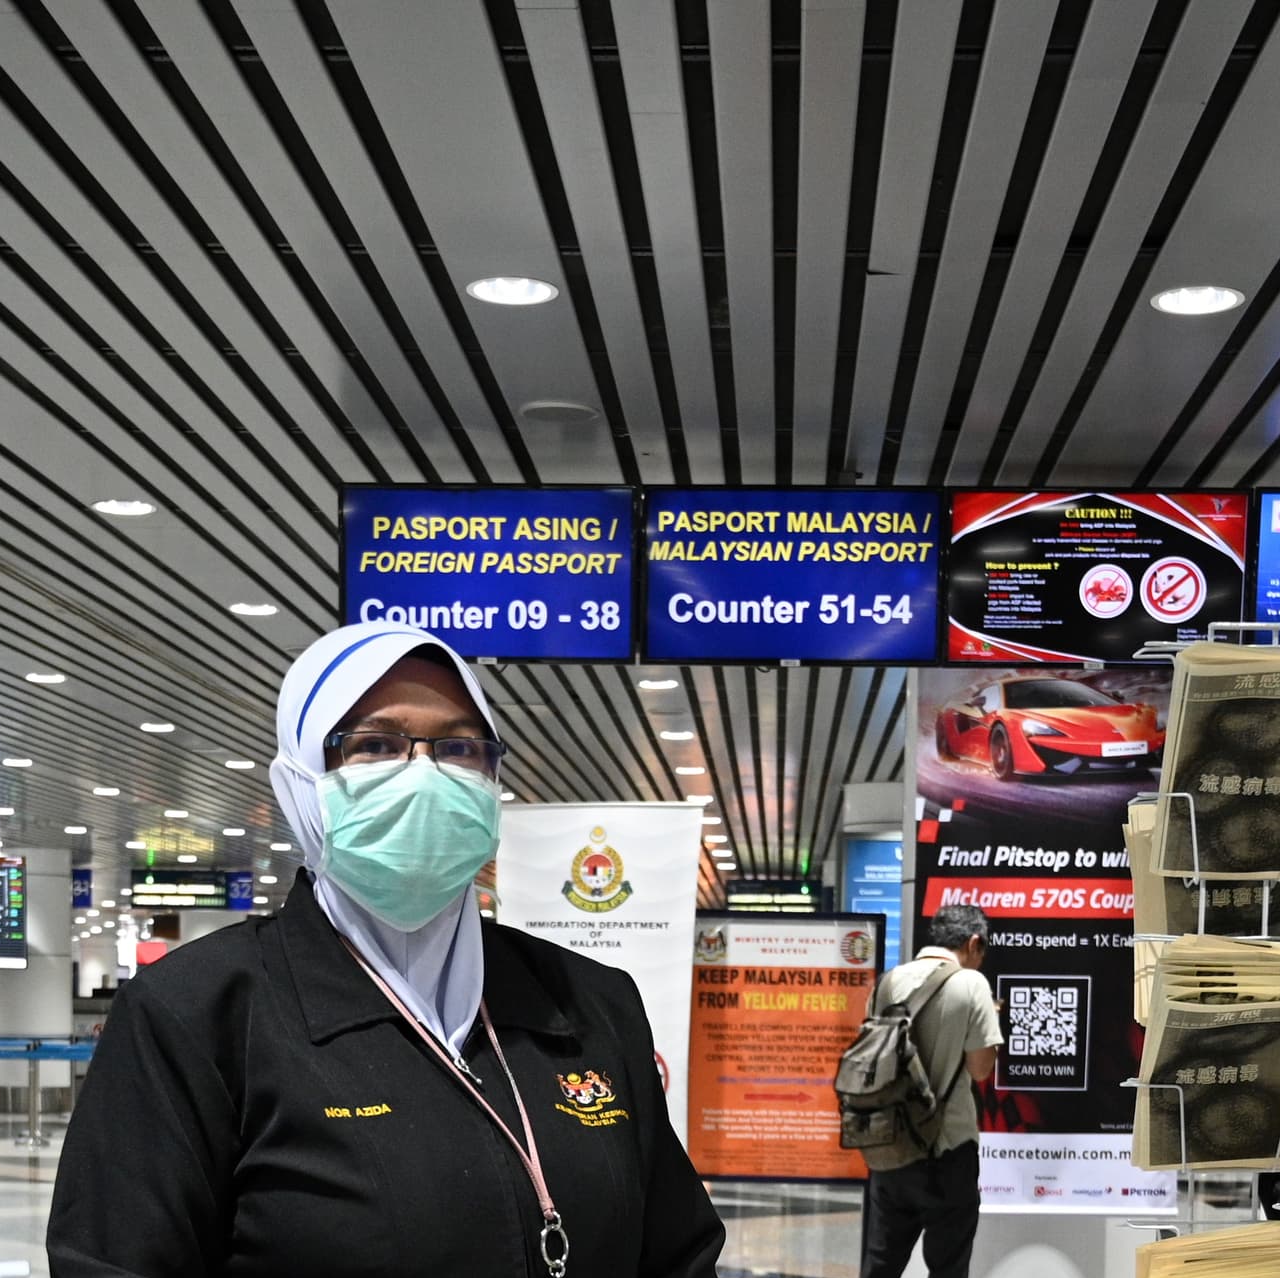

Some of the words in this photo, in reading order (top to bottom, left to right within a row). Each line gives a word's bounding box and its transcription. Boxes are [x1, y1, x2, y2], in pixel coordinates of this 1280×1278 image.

[658, 512, 780, 532] PASPORT
[787, 512, 916, 533] MALAYSIA
[923, 514, 931, 533] /
[1065, 509, 1117, 518] CAUTION
[373, 517, 506, 540] PASPORT
[514, 518, 601, 540] ASING
[608, 519, 618, 540] /
[650, 542, 792, 560] MALAYSIAN
[798, 543, 932, 562] PASSPORT
[360, 552, 475, 572] FOREIGN
[481, 554, 621, 574] PASSPORT
[360, 599, 498, 629] Counter
[508, 600, 547, 630] 09
[581, 601, 620, 630] 38
[669, 593, 809, 623] Counter
[819, 594, 912, 624] 51-54
[1234, 673, 1280, 689] 流感
[938, 846, 991, 866] Final
[994, 846, 1070, 872] Pitstop
[1075, 848, 1096, 867] to
[229, 882, 251, 898] 32
[941, 888, 1026, 908] McLaren
[1031, 888, 1086, 909] 570S
[526, 921, 595, 929] IMMIGRATION
[600, 921, 670, 929] DEPARTMENT
[570, 940, 622, 948] MALAYSIA
[1035, 933, 1076, 950] spend
[1093, 934, 1109, 947] 1X
[698, 969, 739, 985] KEEP
[744, 970, 823, 986] MALAYSIA
[829, 972, 868, 987] FREE
[698, 992, 739, 1008] FROM
[743, 992, 799, 1011] YELLOW
[802, 993, 847, 1012] FEVER
[1009, 1064, 1036, 1076] SCAN
[1039, 1065, 1053, 1076] TO
[1054, 1065, 1074, 1076] WIN
[1176, 1064, 1259, 1085] 流感病毒
[325, 1106, 352, 1118] NOR
[356, 1104, 392, 1117] AZIDA
[1129, 1188, 1166, 1196] PETRON
